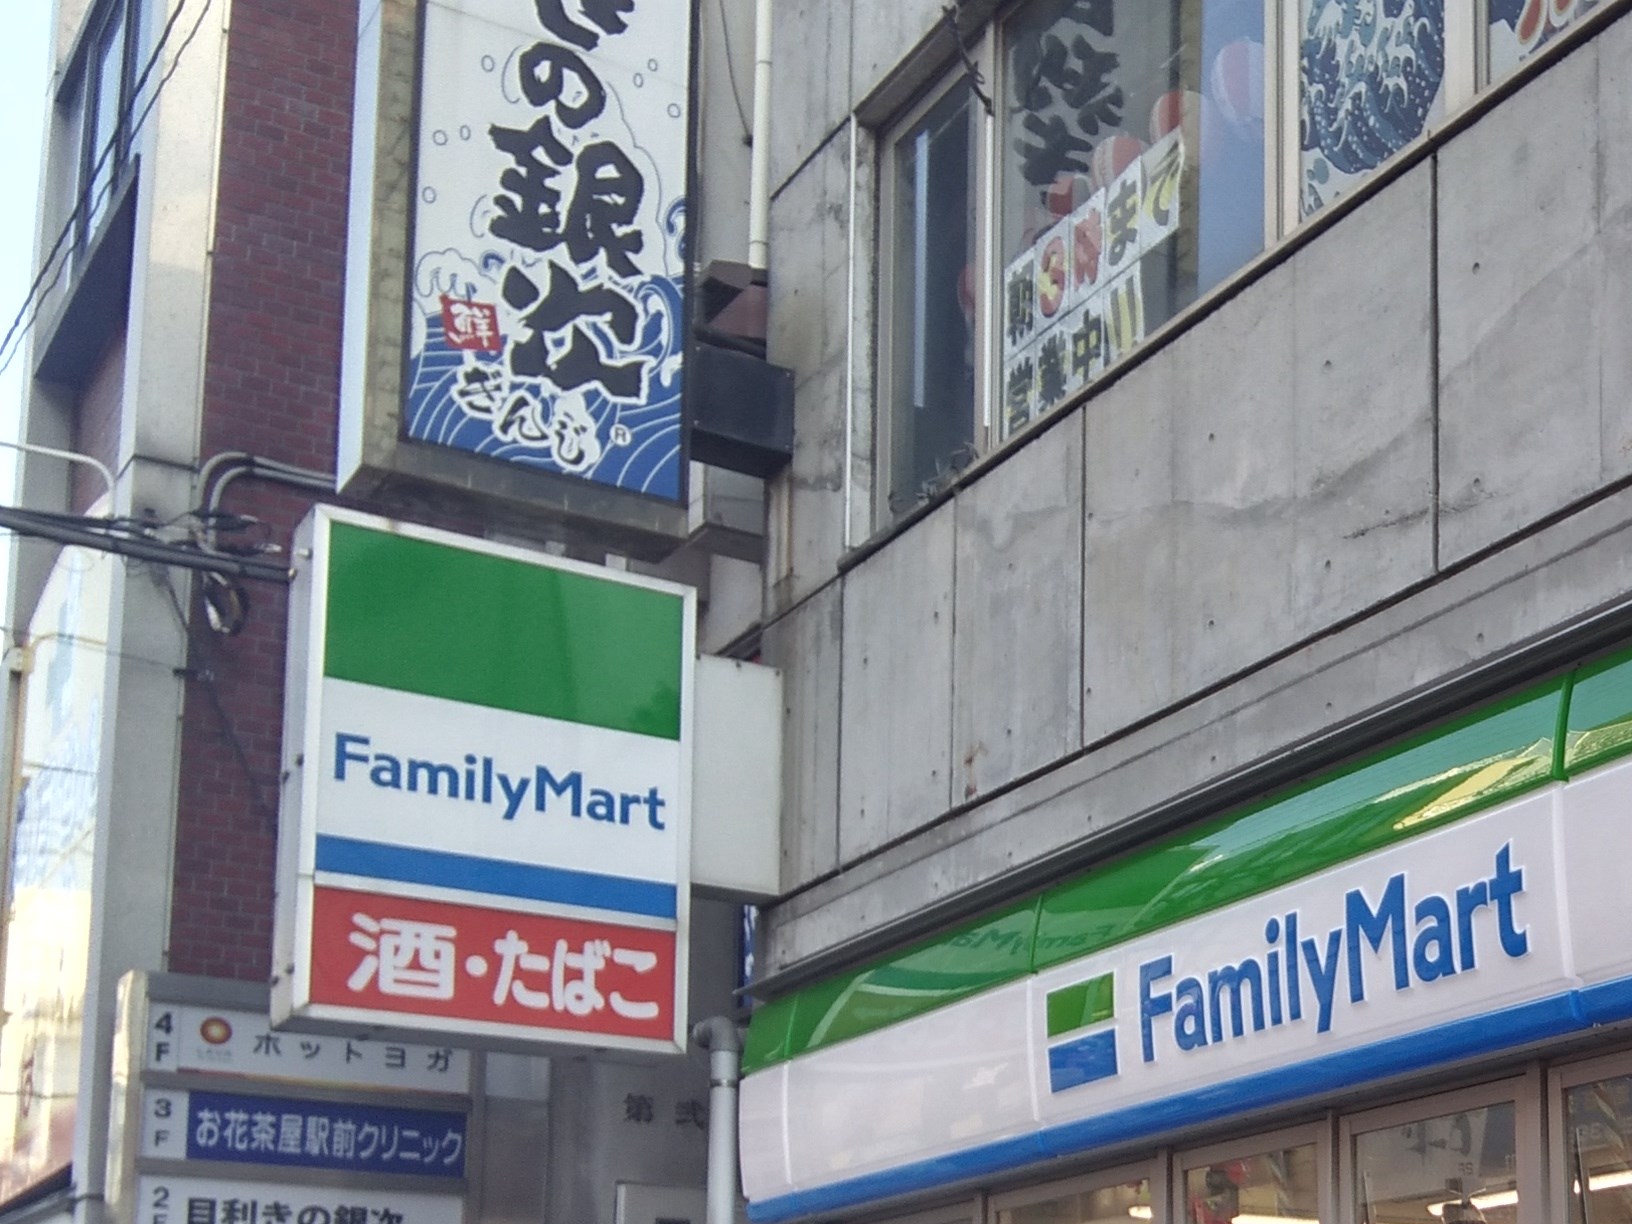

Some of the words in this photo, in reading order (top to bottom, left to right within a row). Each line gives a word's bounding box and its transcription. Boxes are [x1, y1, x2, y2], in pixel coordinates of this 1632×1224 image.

[458, 364, 588, 467] ぎんじ
[334, 732, 666, 831] FamilyMart
[347, 912, 660, 1020] 酒・たばこ
[1139, 840, 1530, 1063] FamilyMart
[253, 1034, 453, 1073] ホットヨガ
[196, 1108, 463, 1165] お花茶屋駅前クリニック
